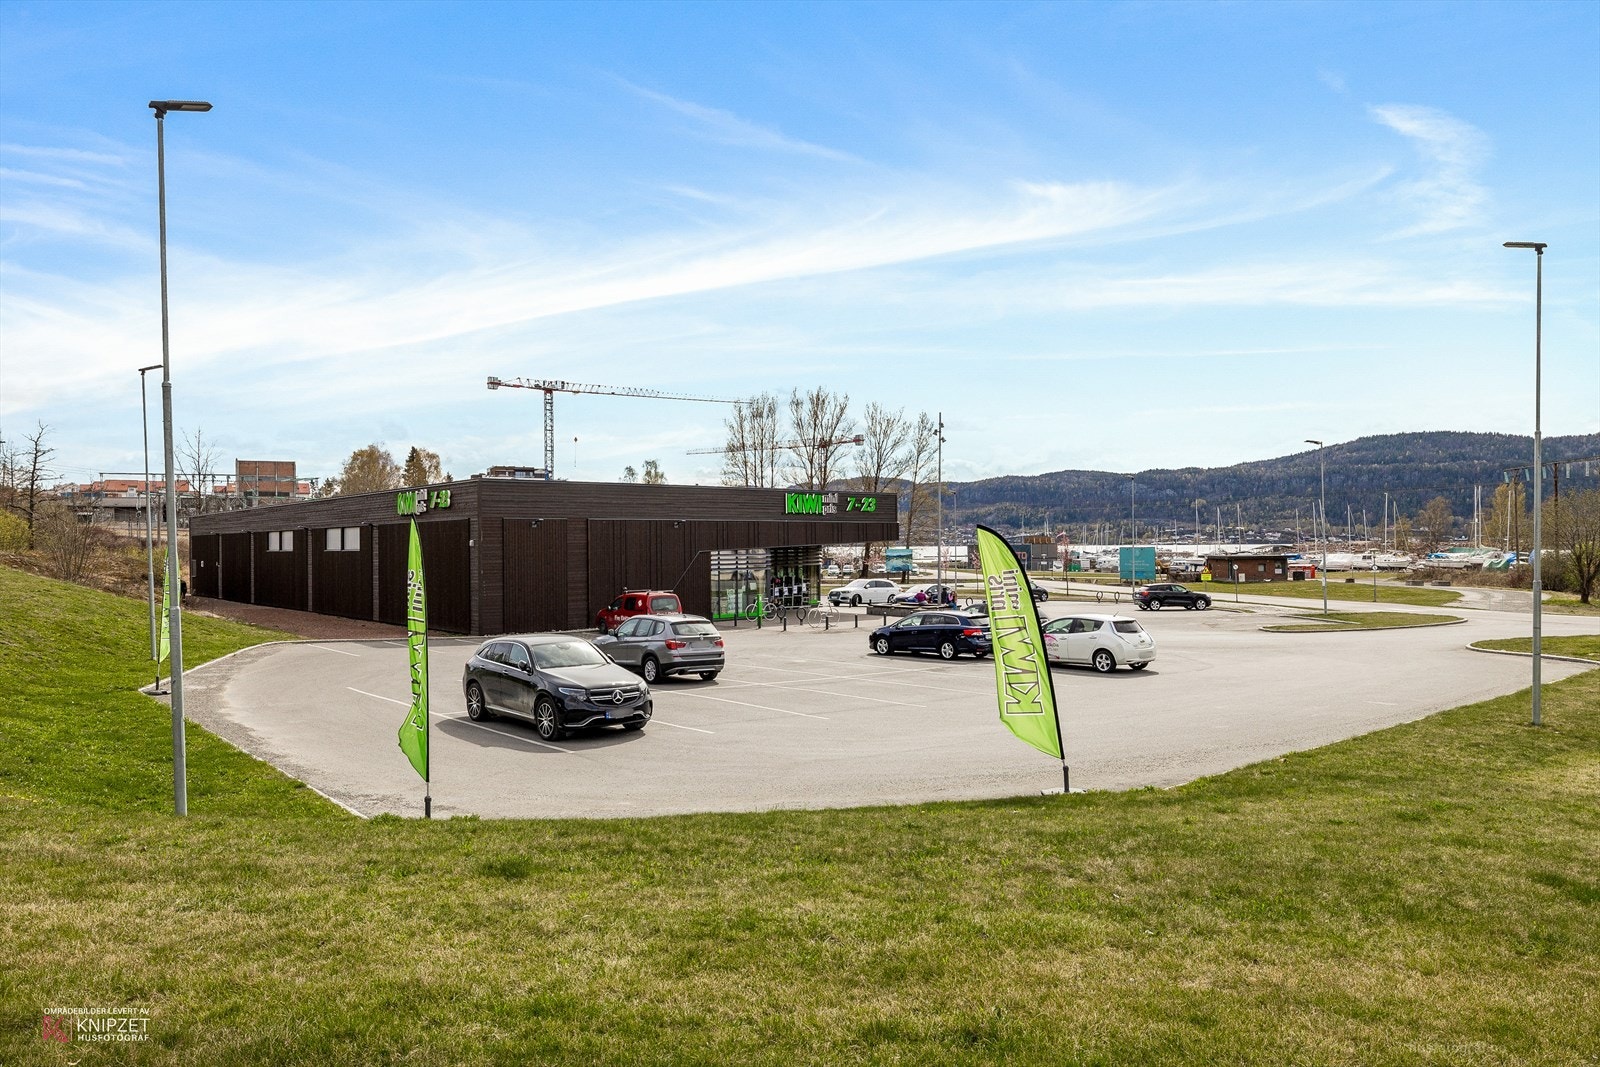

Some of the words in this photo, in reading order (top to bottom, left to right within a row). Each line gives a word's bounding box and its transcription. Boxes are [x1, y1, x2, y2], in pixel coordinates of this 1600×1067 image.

[785, 492, 822, 514] KIWI
[846, 497, 877, 512] 7-23
[822, 503, 837, 515] pris
